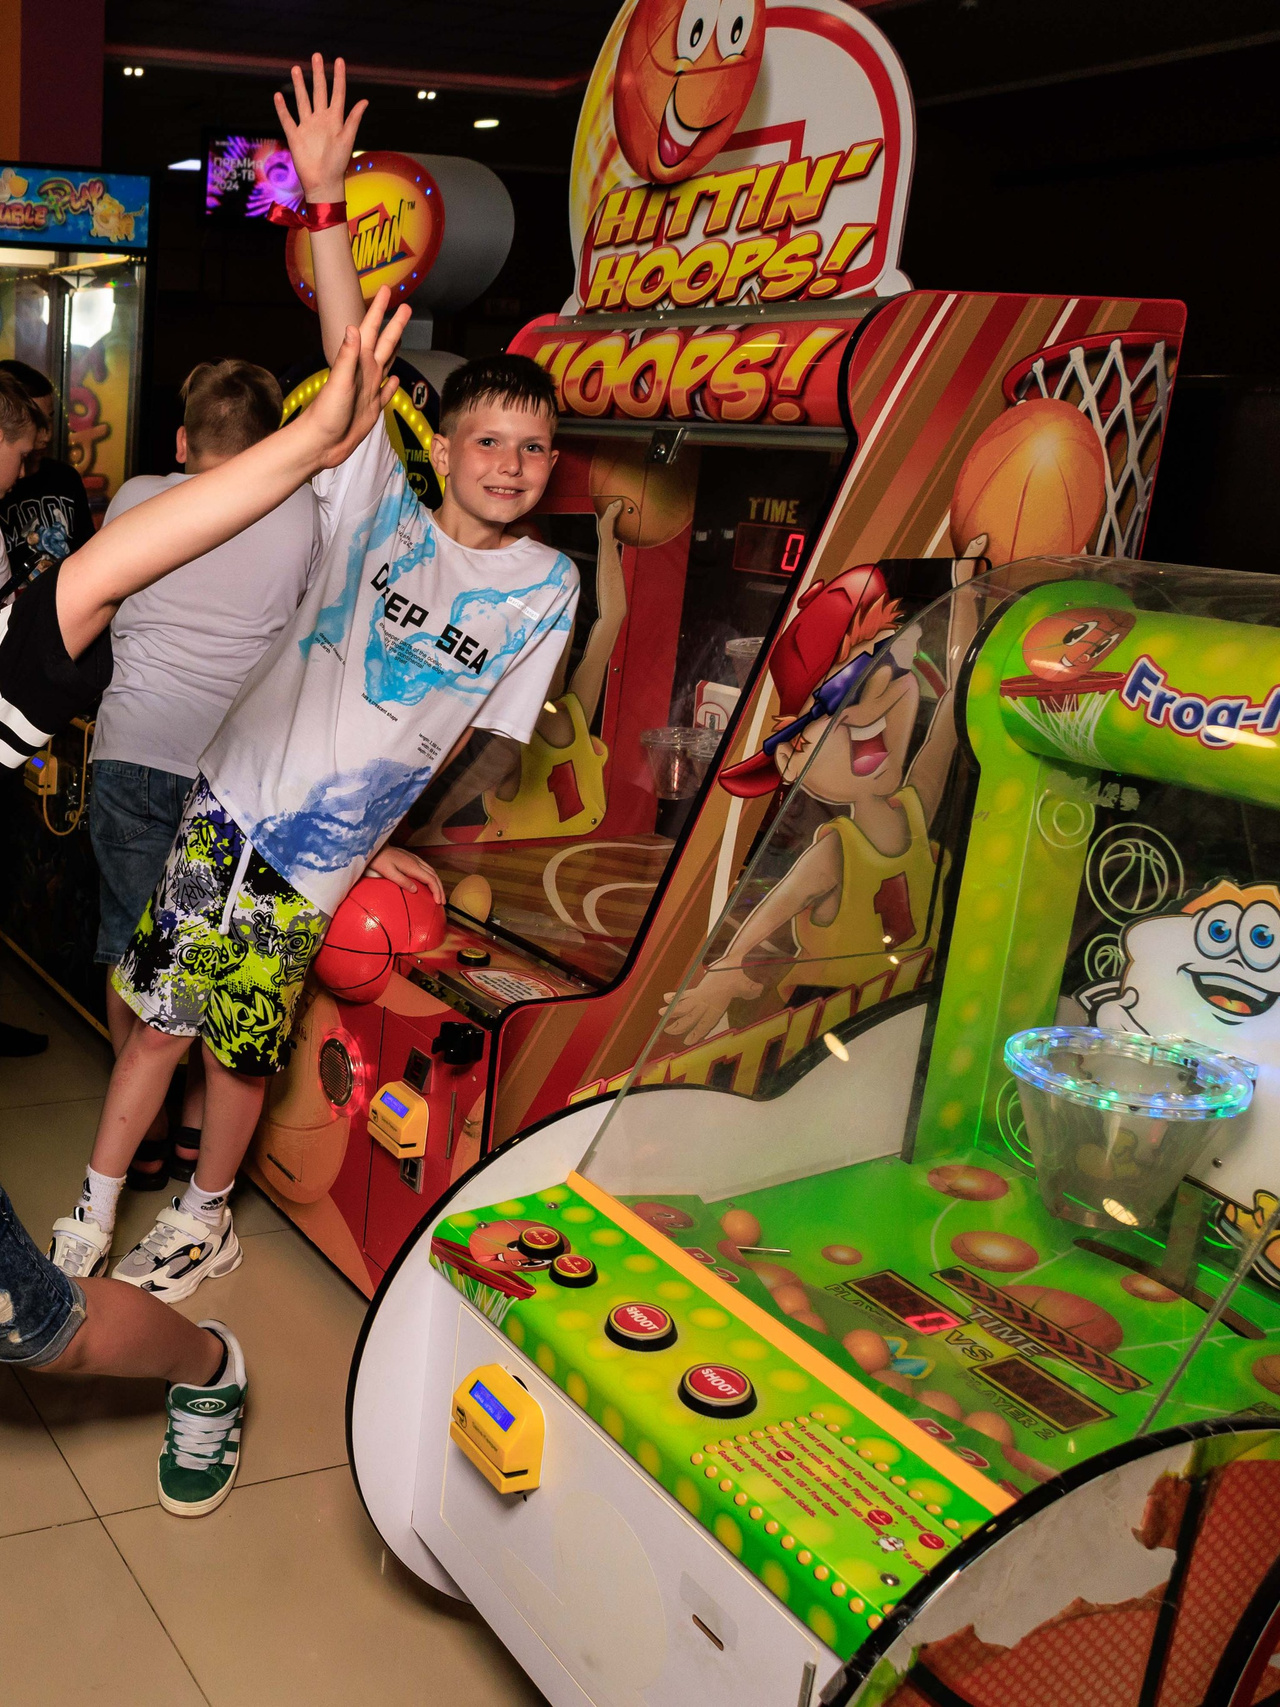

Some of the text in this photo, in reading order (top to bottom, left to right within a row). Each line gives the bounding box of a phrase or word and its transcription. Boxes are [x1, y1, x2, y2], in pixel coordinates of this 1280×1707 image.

[213, 169, 256, 181] МУЗ-ТВ
[213, 180, 239, 191] 2024
[593, 139, 883, 248] HITTIN'
[584, 223, 877, 309] HOOPS!
[405, 449, 429, 464] TIME
[748, 497, 800, 525] TIME
[781, 533, 805, 572] 0
[435, 623, 489, 675] SEA
[1121, 655, 1280, 748] Frog-
[626, 1305, 660, 1331] SHOOT
[967, 1306, 1046, 1358] TIME
[944, 1329, 994, 1363] VS
[700, 1367, 739, 1397] SHOOT
[718, 1450, 735, 1463] Good
[734, 1445, 751, 1459] Score
[748, 1458, 768, 1473] higher
[781, 1486, 797, 1500] more
[750, 1440, 767, 1454] Score
[765, 1453, 784, 1468] higher
[809, 1490, 823, 1502] Free
[821, 1502, 839, 1517] Game
[798, 1443, 810, 1453] two
[808, 1452, 825, 1465] coins
[822, 1464, 840, 1479] Press
[839, 1477, 852, 1489] Two
[851, 1487, 873, 1506] Players
[836, 1457, 855, 1471] Insert
[853, 1470, 866, 1481] One
[865, 1481, 879, 1492] coin
[878, 1491, 895, 1506] Press
[894, 1505, 908, 1516] One
